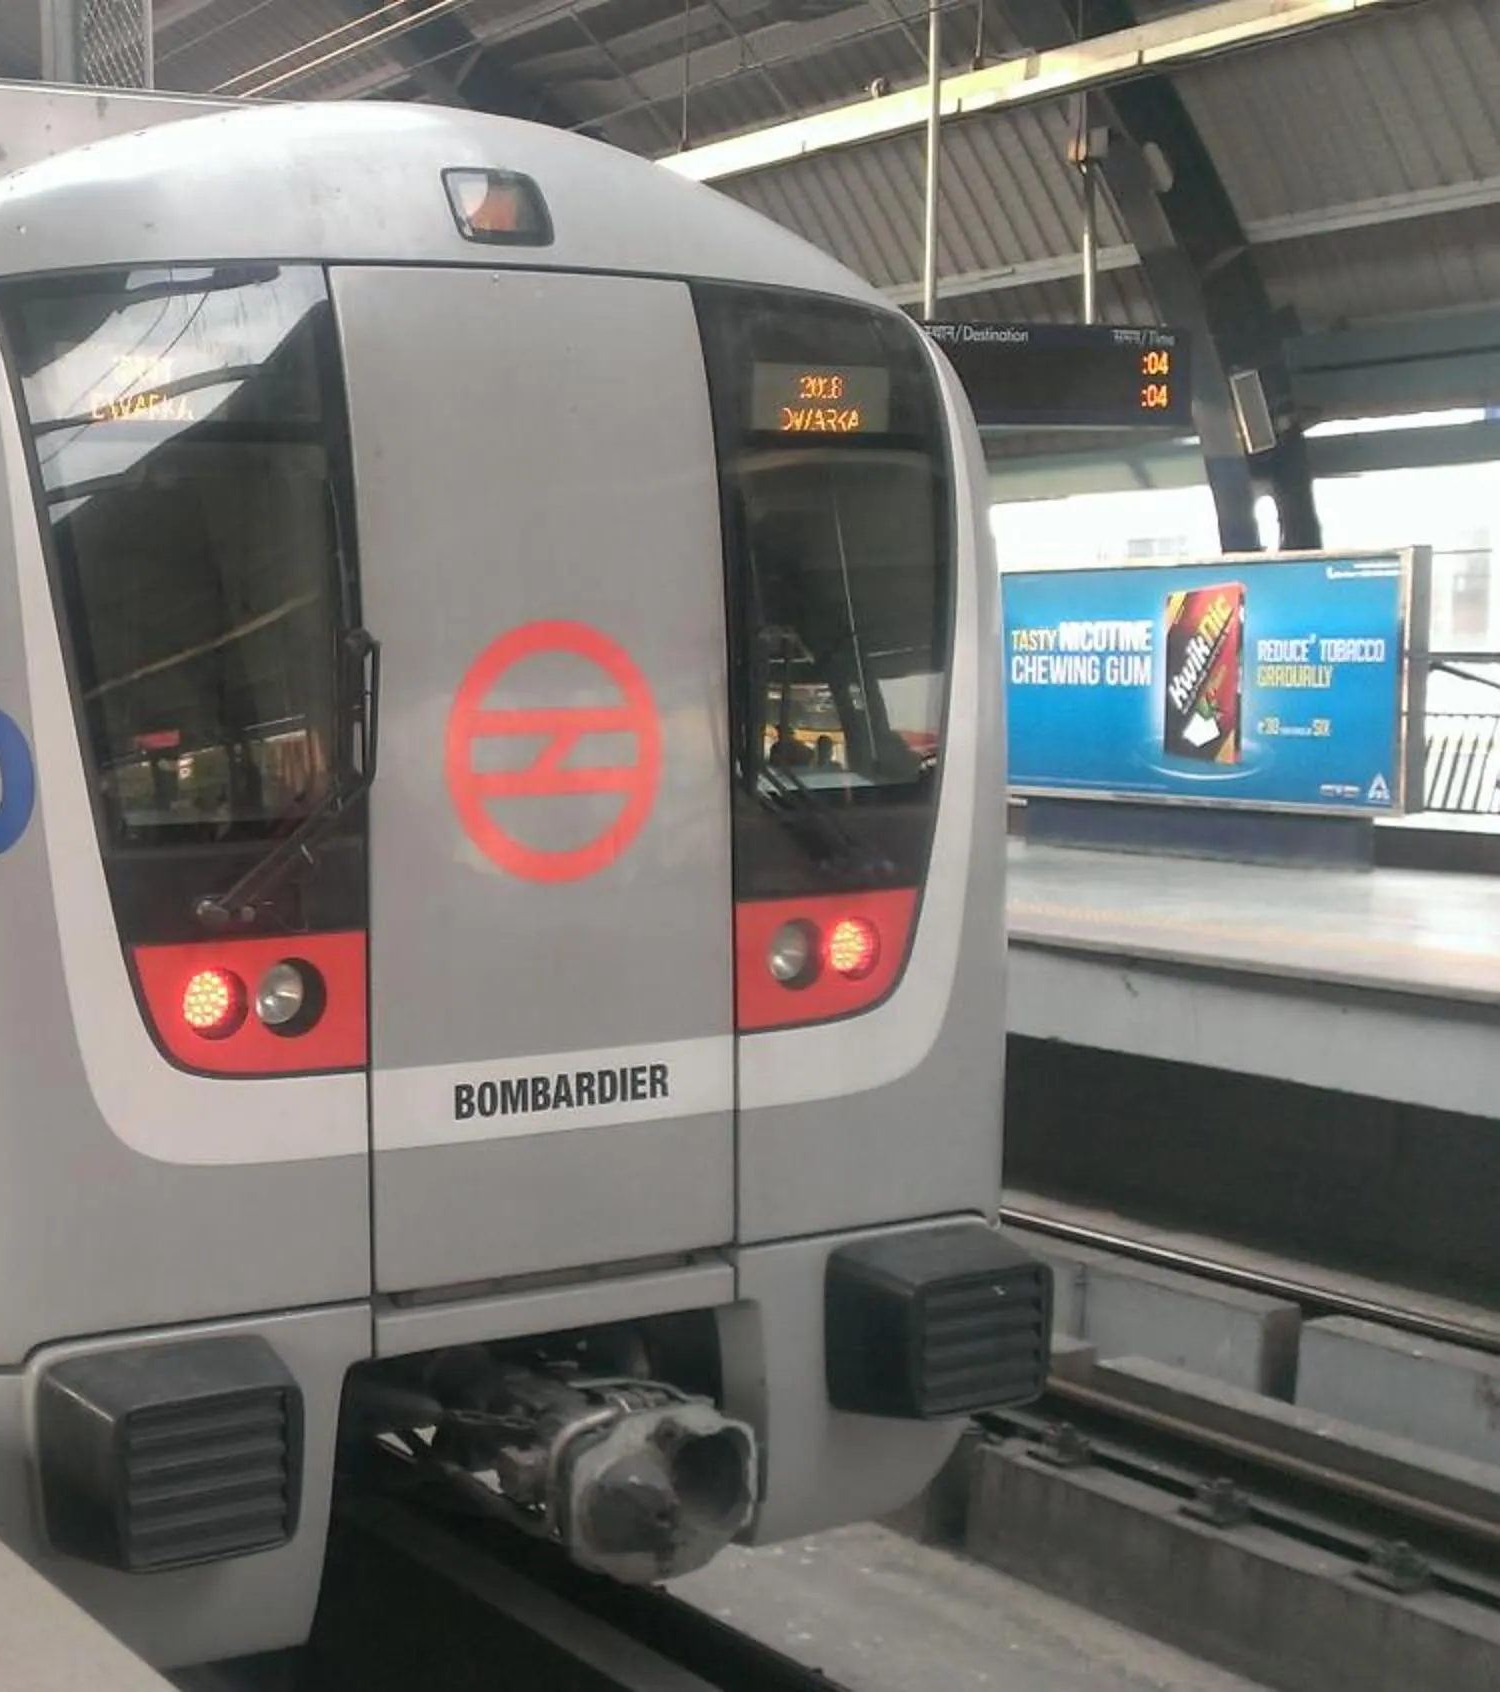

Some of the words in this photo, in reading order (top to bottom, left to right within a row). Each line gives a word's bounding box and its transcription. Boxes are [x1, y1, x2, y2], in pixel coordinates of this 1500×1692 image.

[1011, 629, 1058, 652] TASTY
[1059, 620, 1154, 652] NICOTINE
[1320, 638, 1386, 663] TOBACCO
[1011, 654, 1101, 686] CHEWING
[1105, 654, 1153, 687] GUM
[1257, 665, 1334, 689] GRADUALLY
[454, 1062, 670, 1121] BOMBARDIER
